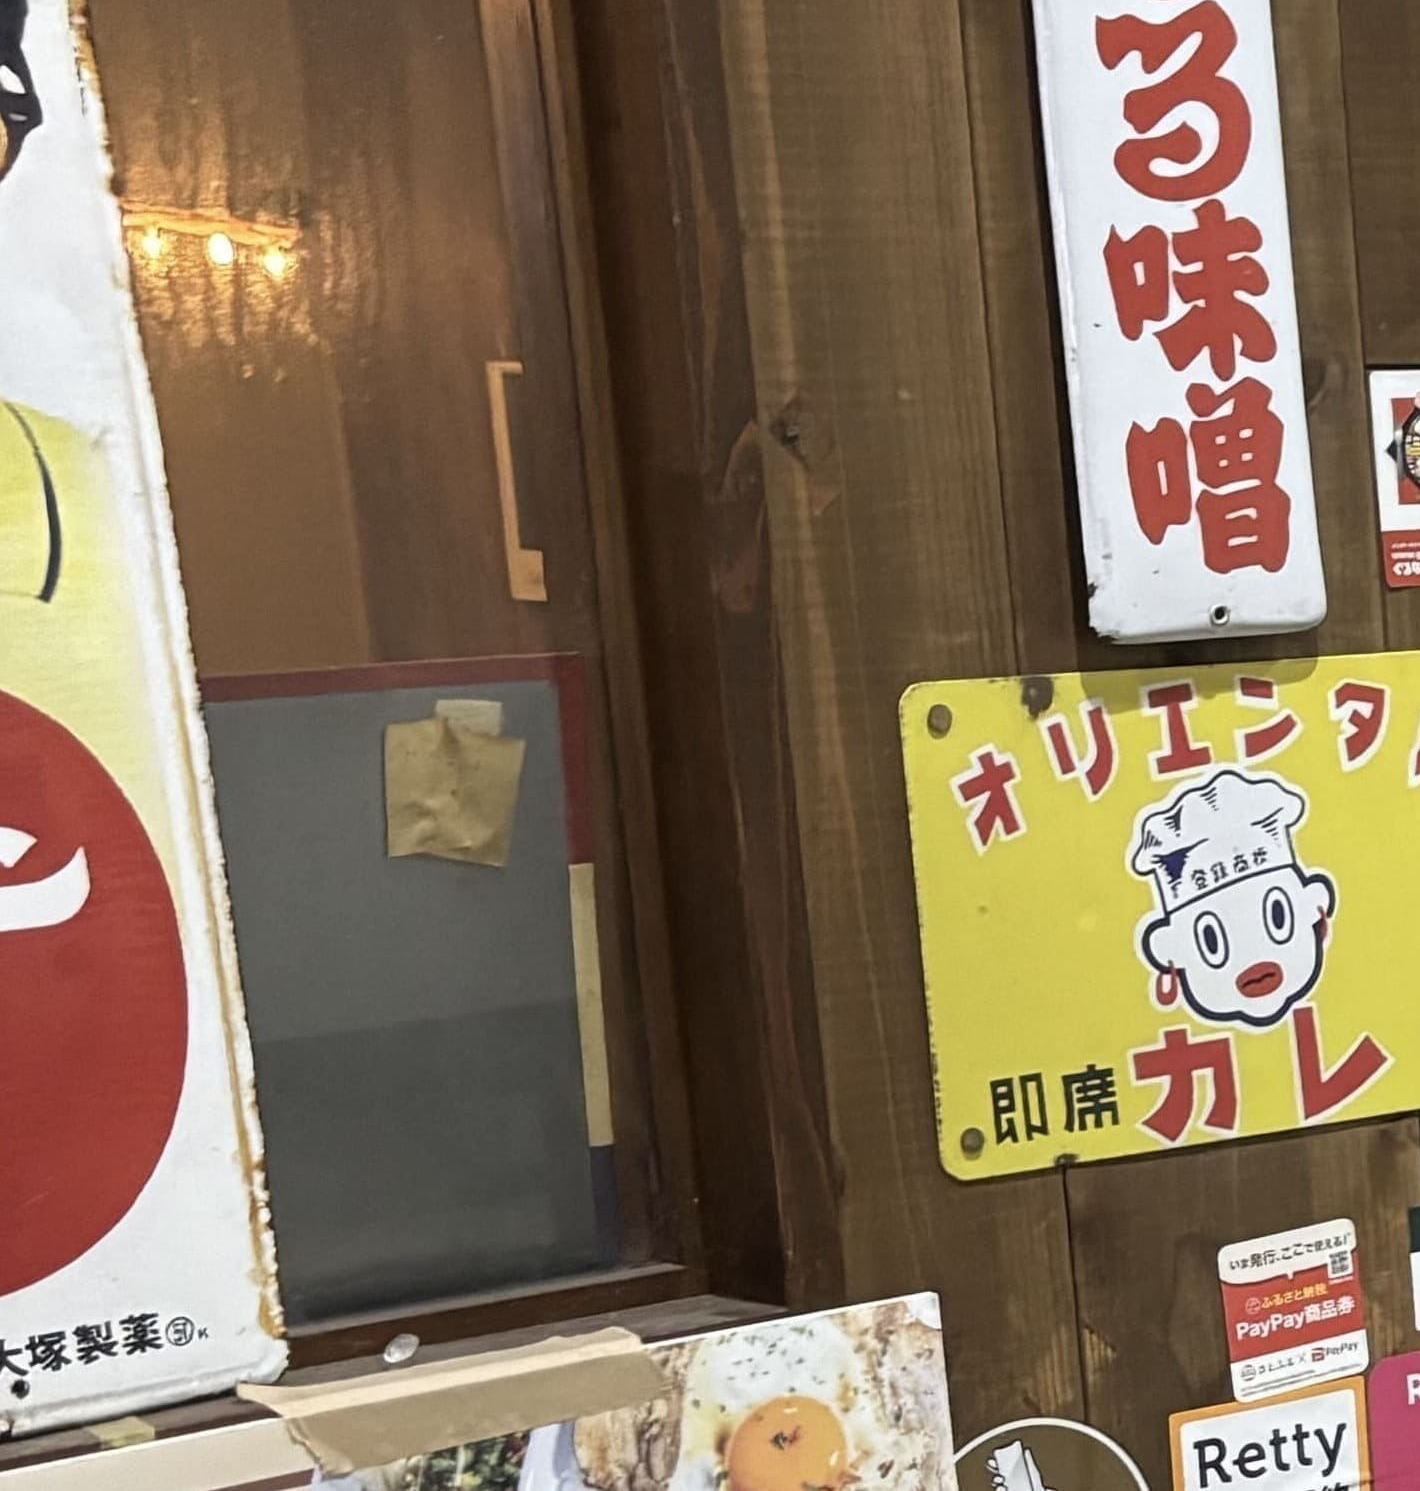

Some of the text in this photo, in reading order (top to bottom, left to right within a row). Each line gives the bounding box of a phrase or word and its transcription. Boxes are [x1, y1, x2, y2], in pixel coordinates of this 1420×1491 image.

[991, 1063, 1120, 1145] 即席
[1235, 1295, 1356, 1340] PayPay商品券
[1193, 1421, 1347, 1489] Retty
